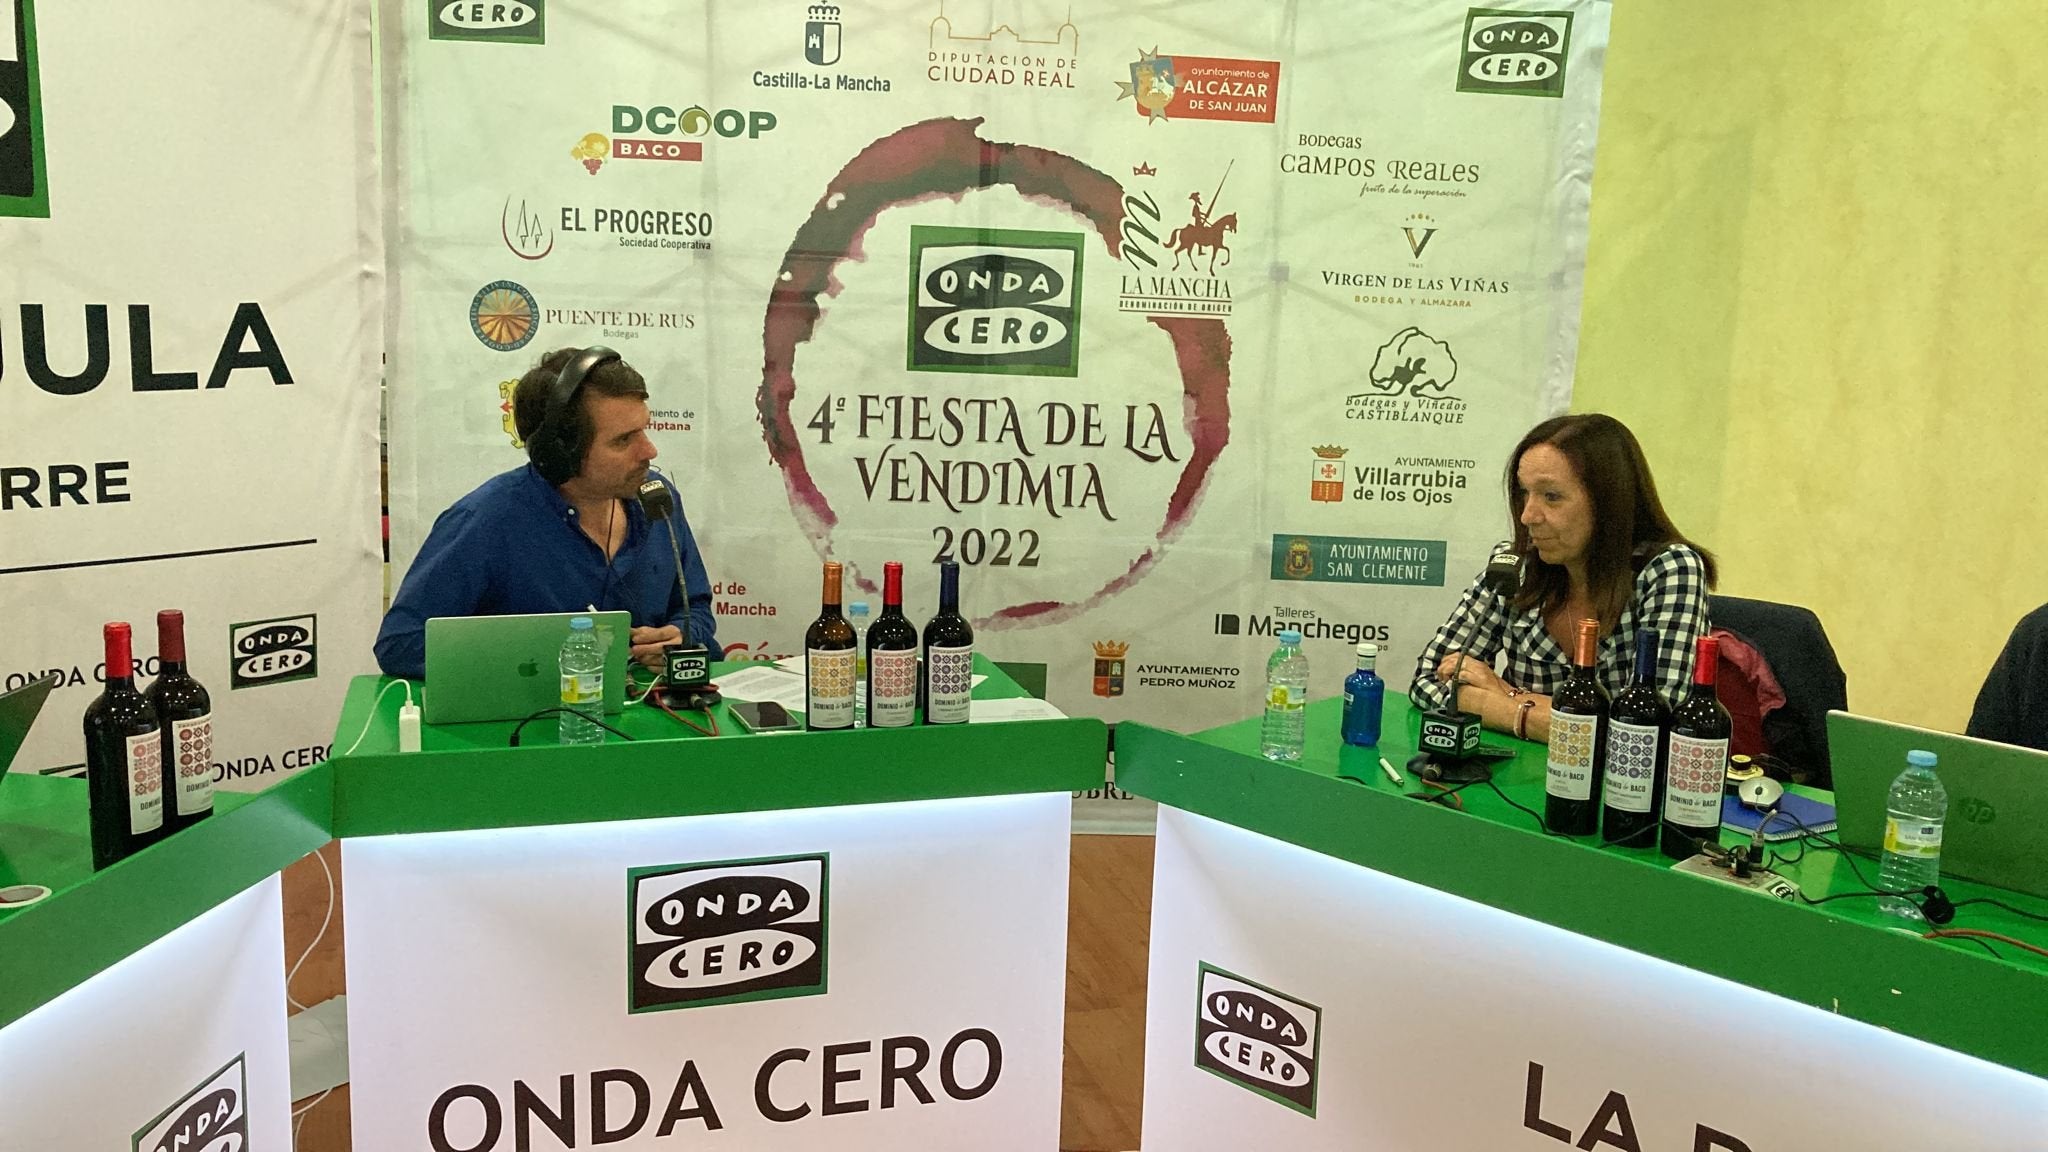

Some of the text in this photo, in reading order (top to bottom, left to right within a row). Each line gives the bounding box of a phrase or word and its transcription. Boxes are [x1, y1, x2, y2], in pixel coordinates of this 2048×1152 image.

[452, 3, 524, 22] CERO
[1481, 29, 1550, 45] ONDA
[928, 51, 1077, 69] DIPUTACIÓN DE
[1481, 57, 1548, 77] CERO
[753, 70, 891, 92] Castilla-La Mancha
[928, 66, 1076, 89] CIUDAD REAL
[1191, 67, 1270, 79] ayuntamiento de
[1182, 78, 1268, 98] ALCÁZAR
[1189, 99, 1267, 113] DE SAN JUAN
[620, 143, 681, 157] BACO
[1388, 183, 1400, 194] de
[1402, 183, 1412, 194] la
[560, 207, 713, 237] EL PROGRESO
[619, 237, 711, 251] Sociedad Cooperativa
[939, 268, 1051, 295] ONDA
[1121, 275, 1232, 298] LA MANCHA
[1321, 270, 1510, 294] VIRGEN DE LAS VIÑAS
[1119, 300, 1232, 313] DENOMINACIÓN DE ORIGEN
[1354, 295, 1403, 305] BODEGA
[1420, 298, 1472, 308] ALMAZARA
[545, 309, 695, 329] PUENTE DE RUS
[603, 328, 639, 341] Bodegas
[943, 316, 1049, 345] CERO
[0, 301, 295, 396] ULA
[1345, 396, 1468, 411] Bodegas y Viñedos
[682, 410, 695, 419] de
[1345, 408, 1465, 426] CASTIBLANQUE
[857, 394, 1035, 458] FIESTA
[1038, 401, 1107, 448] DE
[1123, 402, 1181, 464] LA
[1394, 457, 1476, 469] AYUNTAMIENTO
[854, 443, 1118, 522] VENDIMIA
[1354, 466, 1467, 489] Villarrubia
[1353, 486, 1453, 507] de los Ojos
[931, 525, 1042, 568] 2022
[1329, 543, 1428, 562] AYUNTAMIENTO
[1327, 562, 1428, 581] SAN CLEMENTE
[727, 582, 746, 596] de
[715, 601, 777, 616] Mancha
[1273, 606, 1316, 619] Talleres
[1247, 614, 1389, 645] Manchegos
[244, 630, 303, 650] ONDA
[248, 653, 303, 674] CERO
[1136, 664, 1240, 677] AYUNTAMIENTO
[1139, 676, 1237, 689] PEDRO MUÑOZ
[1427, 725, 1454, 736] ONDA
[1428, 737, 1452, 746] CERO
[661, 889, 796, 926] ONDA
[668, 940, 795, 979] CERO
[1215, 995, 1297, 1042] ONDA
[1218, 1035, 1296, 1081] CERO
[426, 1027, 1003, 1152] ONDA CERO
[1523, 1060, 1643, 1152] LA
